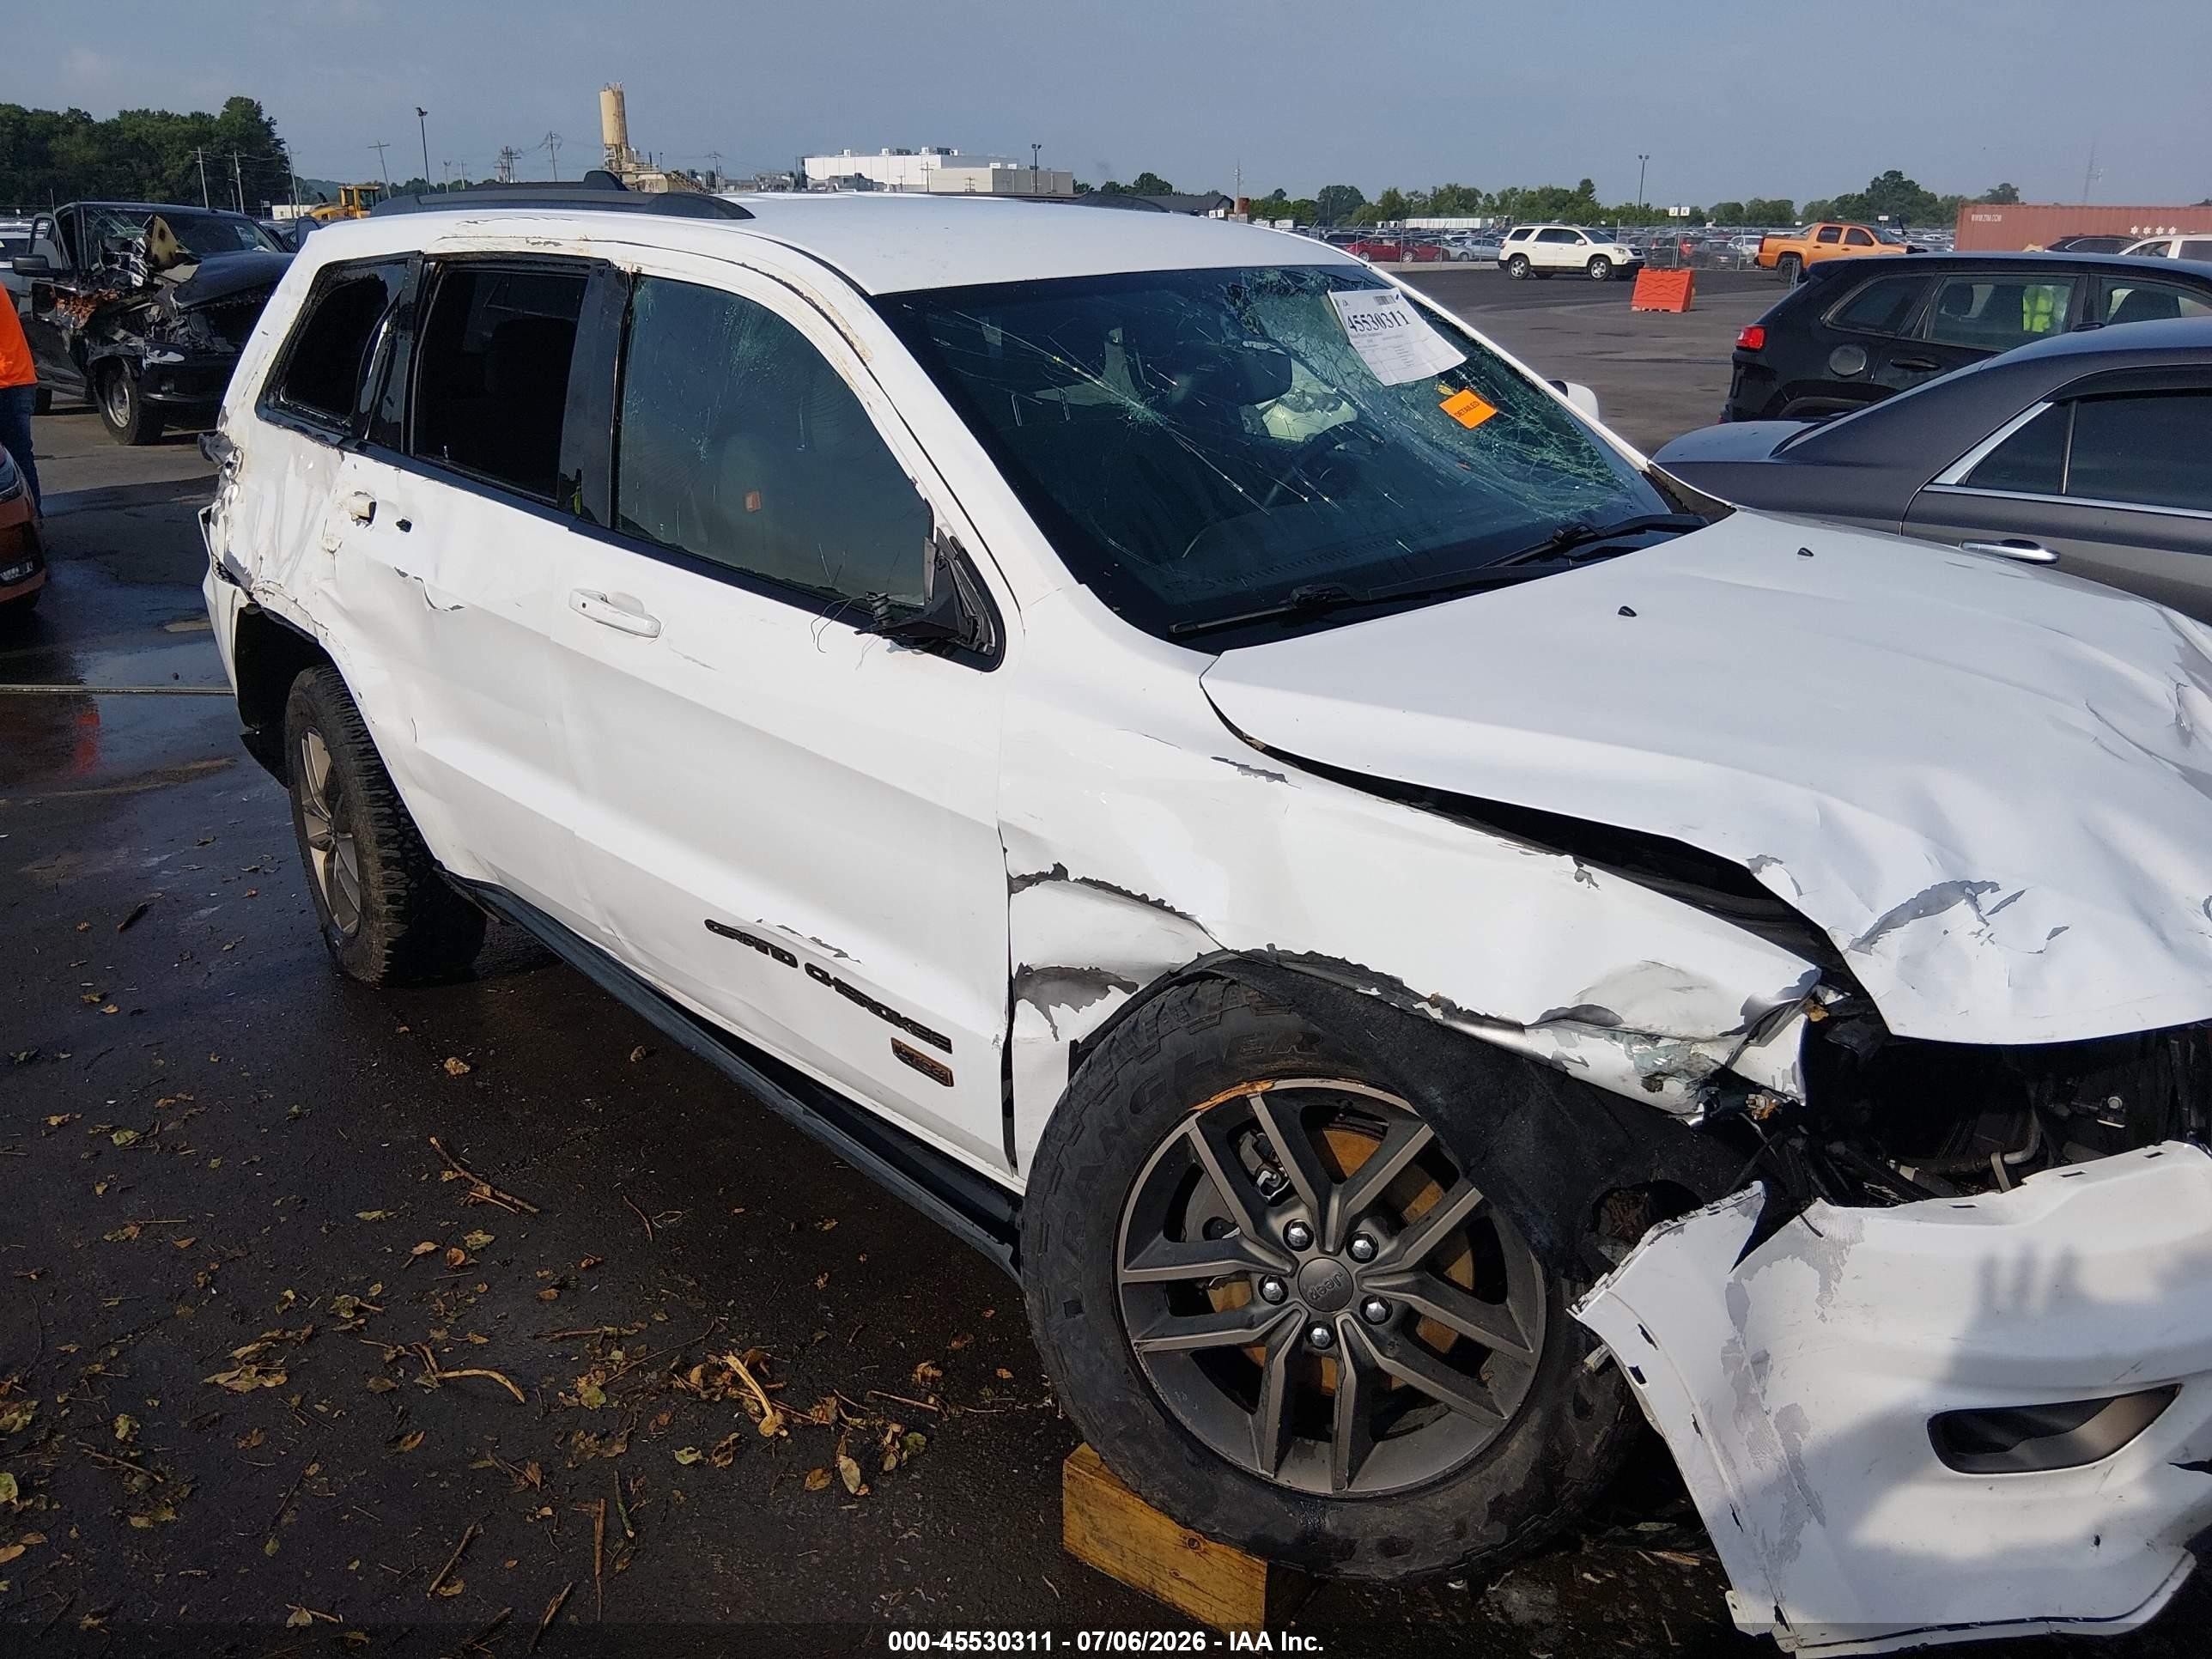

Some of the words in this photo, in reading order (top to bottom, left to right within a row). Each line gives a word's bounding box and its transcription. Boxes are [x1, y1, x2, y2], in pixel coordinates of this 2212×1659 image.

[1346, 310, 1411, 333] 45530311
[1455, 400, 1480, 418] DETAILED
[1307, 1271, 1344, 1302] Jeep
